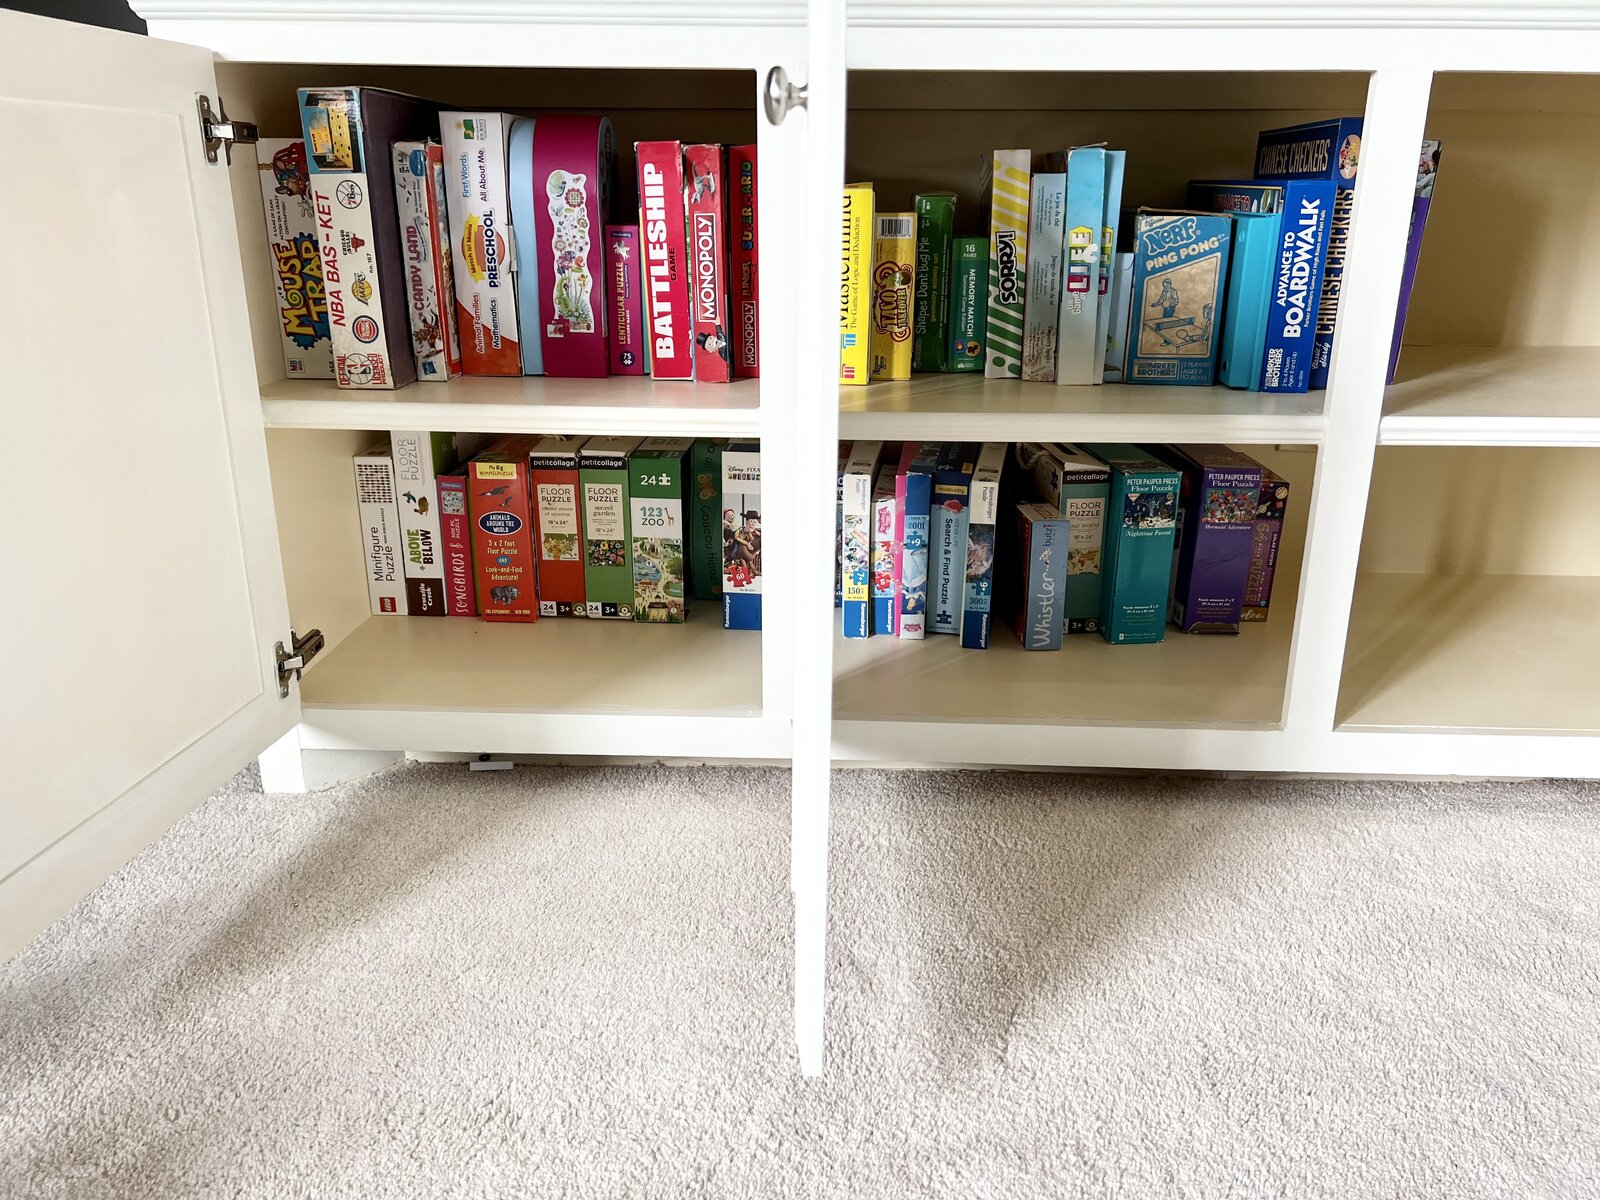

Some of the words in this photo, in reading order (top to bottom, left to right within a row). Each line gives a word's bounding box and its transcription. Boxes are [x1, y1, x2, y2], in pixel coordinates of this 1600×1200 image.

[460, 154, 469, 181] Words
[476, 149, 485, 163] Me
[1258, 144, 1288, 175] CHINESE
[1288, 138, 1331, 174] CHECKERS
[461, 181, 471, 198] First
[477, 165, 487, 190] About
[741, 161, 752, 204] MARIO
[478, 190, 488, 202] All
[406, 225, 421, 261] LAND
[466, 223, 474, 243] Mania
[741, 207, 753, 250] SUPER
[918, 237, 929, 251] Me
[1284, 231, 1295, 248] TO
[1325, 189, 1355, 268] CHECKERS
[467, 253, 478, 274] Match
[483, 210, 499, 288] PRESCHOOL
[643, 162, 675, 359] BATTLESHIP
[669, 247, 677, 281] GAME
[918, 254, 931, 271] Bug
[965, 244, 976, 253] 16
[1069, 232, 1091, 289] LIFE
[1145, 252, 1178, 271] PING
[1180, 236, 1219, 259] PONG
[300, 240, 328, 323] TRAP
[616, 262, 624, 293] PUZZLE
[697, 216, 716, 319] MONOPOLY
[741, 262, 751, 296] JUNIOR
[852, 268, 860, 285] Logic
[931, 266, 939, 289] activity
[995, 231, 1017, 305] SORRY!
[1276, 250, 1293, 307] ADVANCE
[1283, 199, 1320, 338] BOARDWALK
[272, 239, 317, 337] MOUSE
[356, 271, 368, 305] LAKERS
[409, 265, 425, 311] CANDY
[852, 286, 858, 294] of
[916, 274, 928, 297] Don't
[968, 269, 976, 305] MEMORY
[1306, 291, 1314, 311] Brothers
[332, 290, 346, 327] NBA
[472, 294, 481, 325] Families
[879, 289, 898, 328] TACO
[897, 288, 907, 328] TAKEOVER
[916, 300, 928, 334] Shapes
[930, 291, 938, 322] geometry
[1071, 291, 1082, 315] Game
[1316, 272, 1343, 335] CHINESE
[489, 299, 501, 349] Mathematics
[617, 296, 626, 345] LENTICULAR
[744, 303, 754, 364] MONOPOLY
[967, 306, 975, 337] MATCH!
[474, 326, 484, 354] Animal
[1320, 342, 1330, 368] Sturdy
[289, 360, 298, 371] MB
[337, 354, 350, 385] OFFICIAL
[367, 353, 382, 385] LICENSED
[379, 354, 387, 384] PRODUCT
[623, 352, 632, 360] 75
[1266, 348, 1276, 377] PARKER
[1272, 348, 1283, 387] BROTHERS
[1312, 347, 1321, 370] Classic
[399, 439, 411, 481] FLOOR
[407, 438, 420, 481] PUZZLE
[727, 465, 744, 473] Disney
[640, 475, 657, 485] 24
[1067, 473, 1109, 481] petitcollage
[640, 506, 663, 517] 123
[987, 486, 995, 519] Ravensburger
[641, 518, 664, 526] ZOO
[701, 505, 714, 549] Coucou
[944, 518, 953, 547] Search
[1043, 523, 1053, 547] butzi
[1255, 523, 1269, 542] 64
[370, 527, 384, 581] Minifigure
[406, 529, 422, 564] ABOVE
[421, 529, 434, 565] BELOW
[487, 547, 499, 555] Floor
[383, 546, 395, 581] Puzzle
[491, 573, 519, 581] Adventure!
[451, 552, 469, 613] SONGBIRDS
[941, 578, 950, 605] Puzzle
[1246, 558, 1263, 602] PUZZLE
[383, 598, 394, 612] LEGO
[419, 582, 427, 611] Crocodile
[969, 597, 984, 605] 300
[980, 614, 988, 648] Ravensburger
